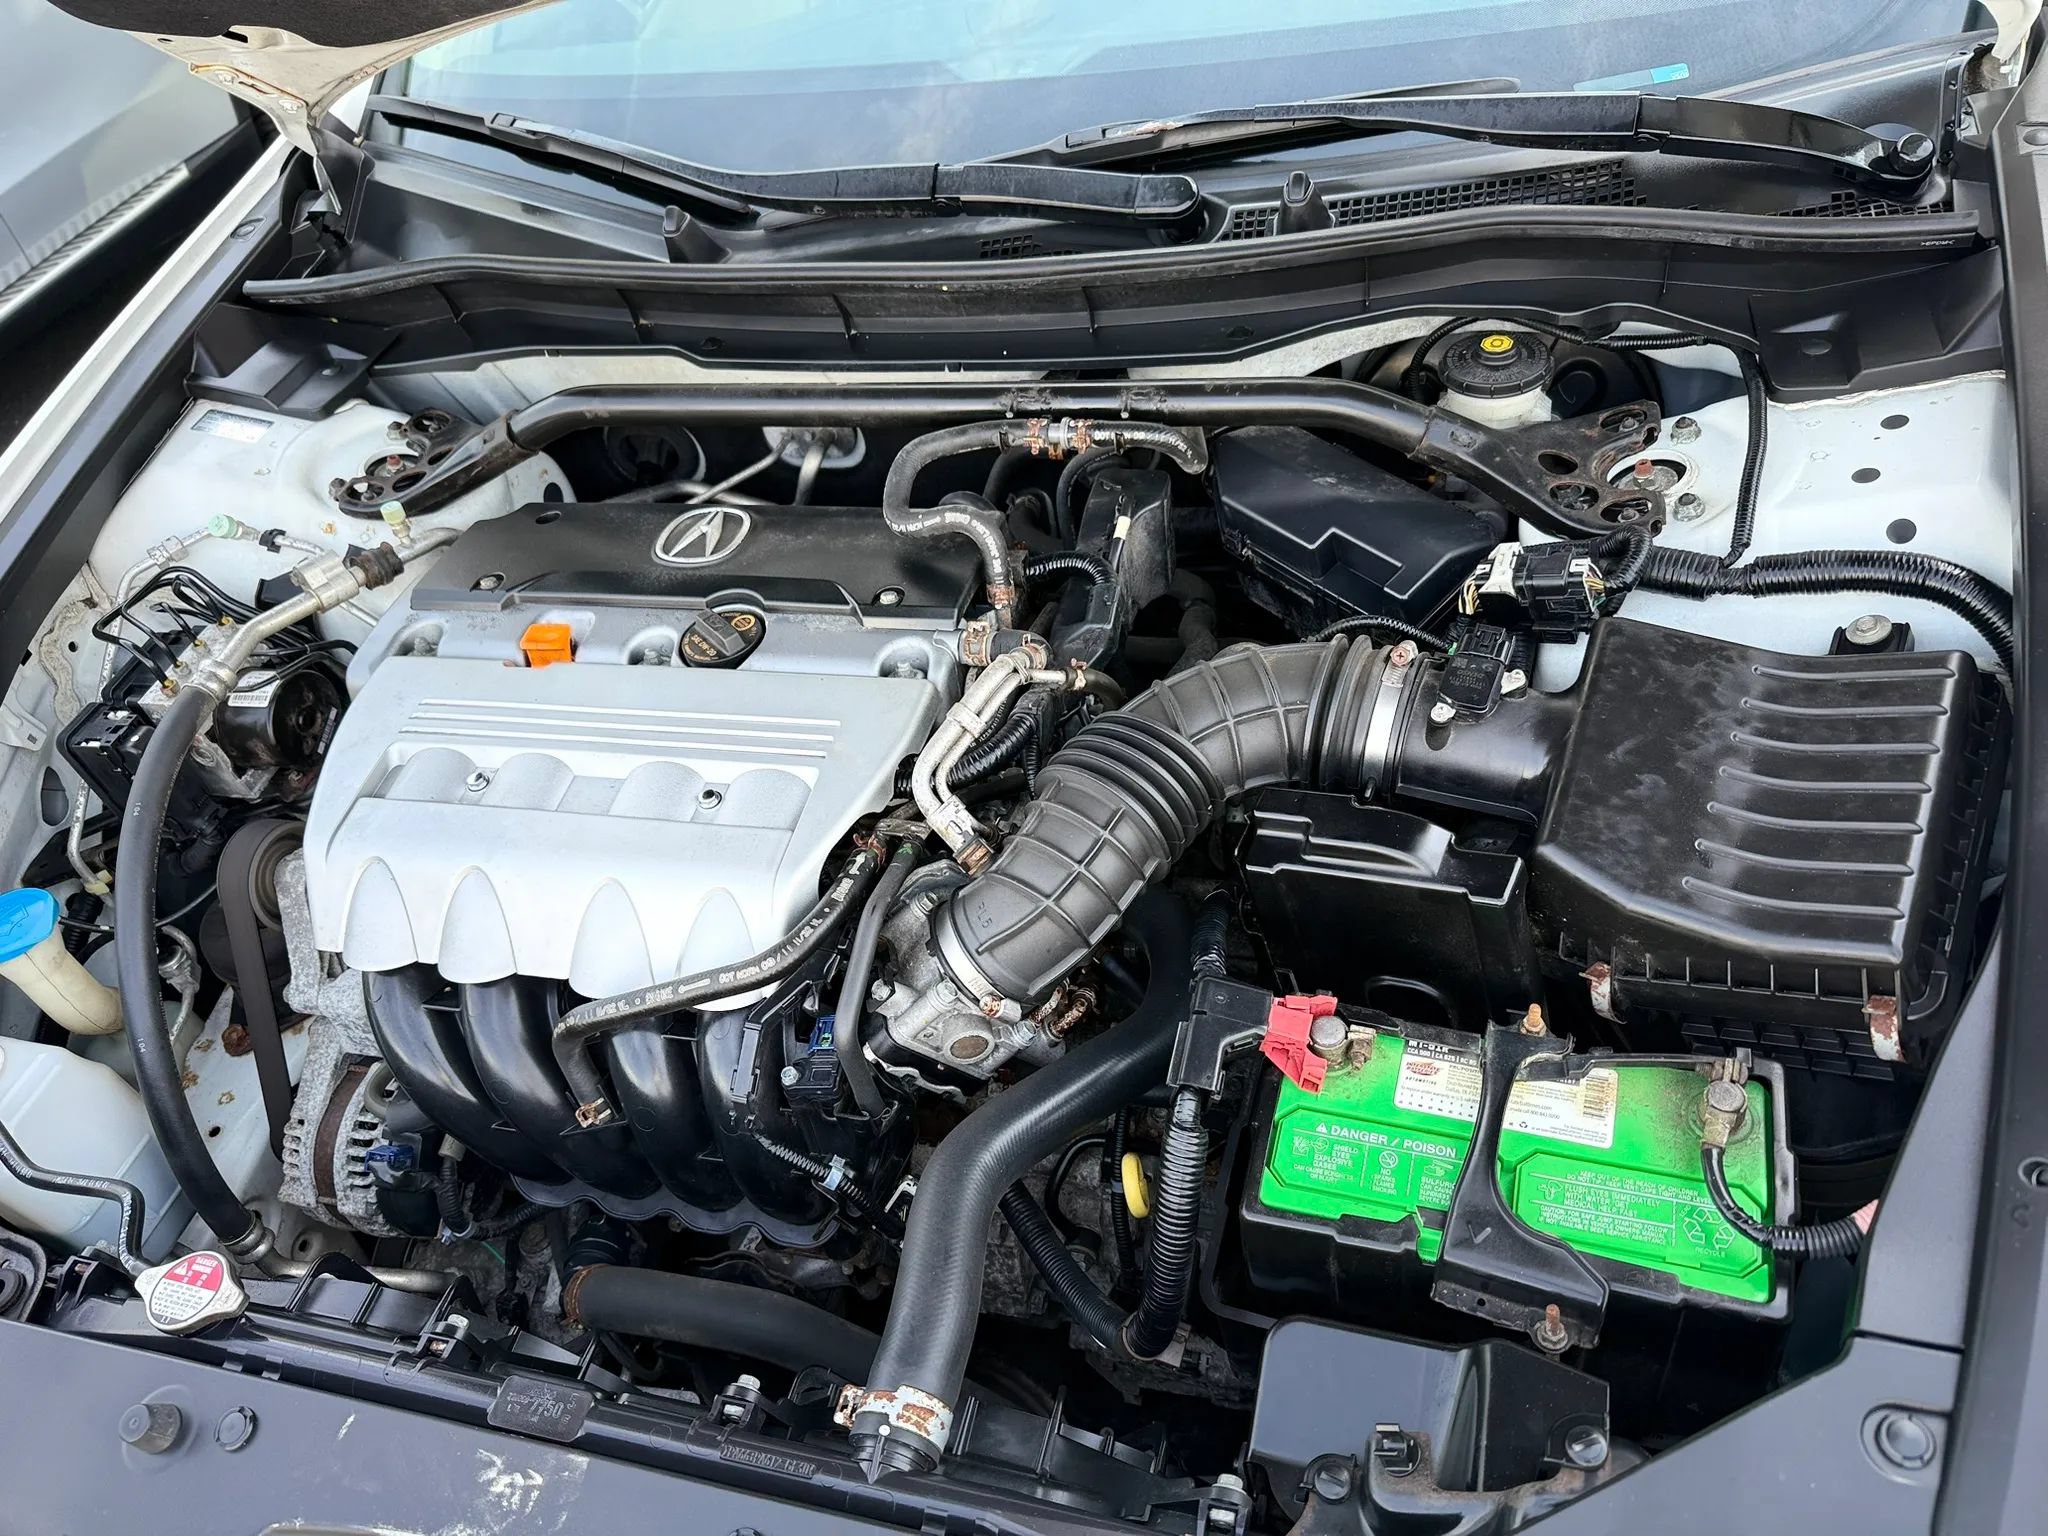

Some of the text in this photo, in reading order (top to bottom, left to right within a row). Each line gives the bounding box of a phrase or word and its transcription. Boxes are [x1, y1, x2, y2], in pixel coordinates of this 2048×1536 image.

[1330, 1125, 1388, 1145] DANGER
[1403, 1139, 1456, 1158] POISON
[1331, 1150, 1350, 1159] EYES
[1332, 1143, 1358, 1154] SHIELD
[1313, 1154, 1353, 1167] EXPLOSIVE
[1564, 1184, 1660, 1207] FLUSH EYES IMMEDIATELY
[1564, 1192, 1582, 1200] WITH
[1667, 1186, 1698, 1196] CHILDREN
[1563, 1198, 1596, 1210] MEDICAL
[1598, 1205, 1616, 1213] HELP
[1694, 1246, 1727, 1259] RECYCLE
